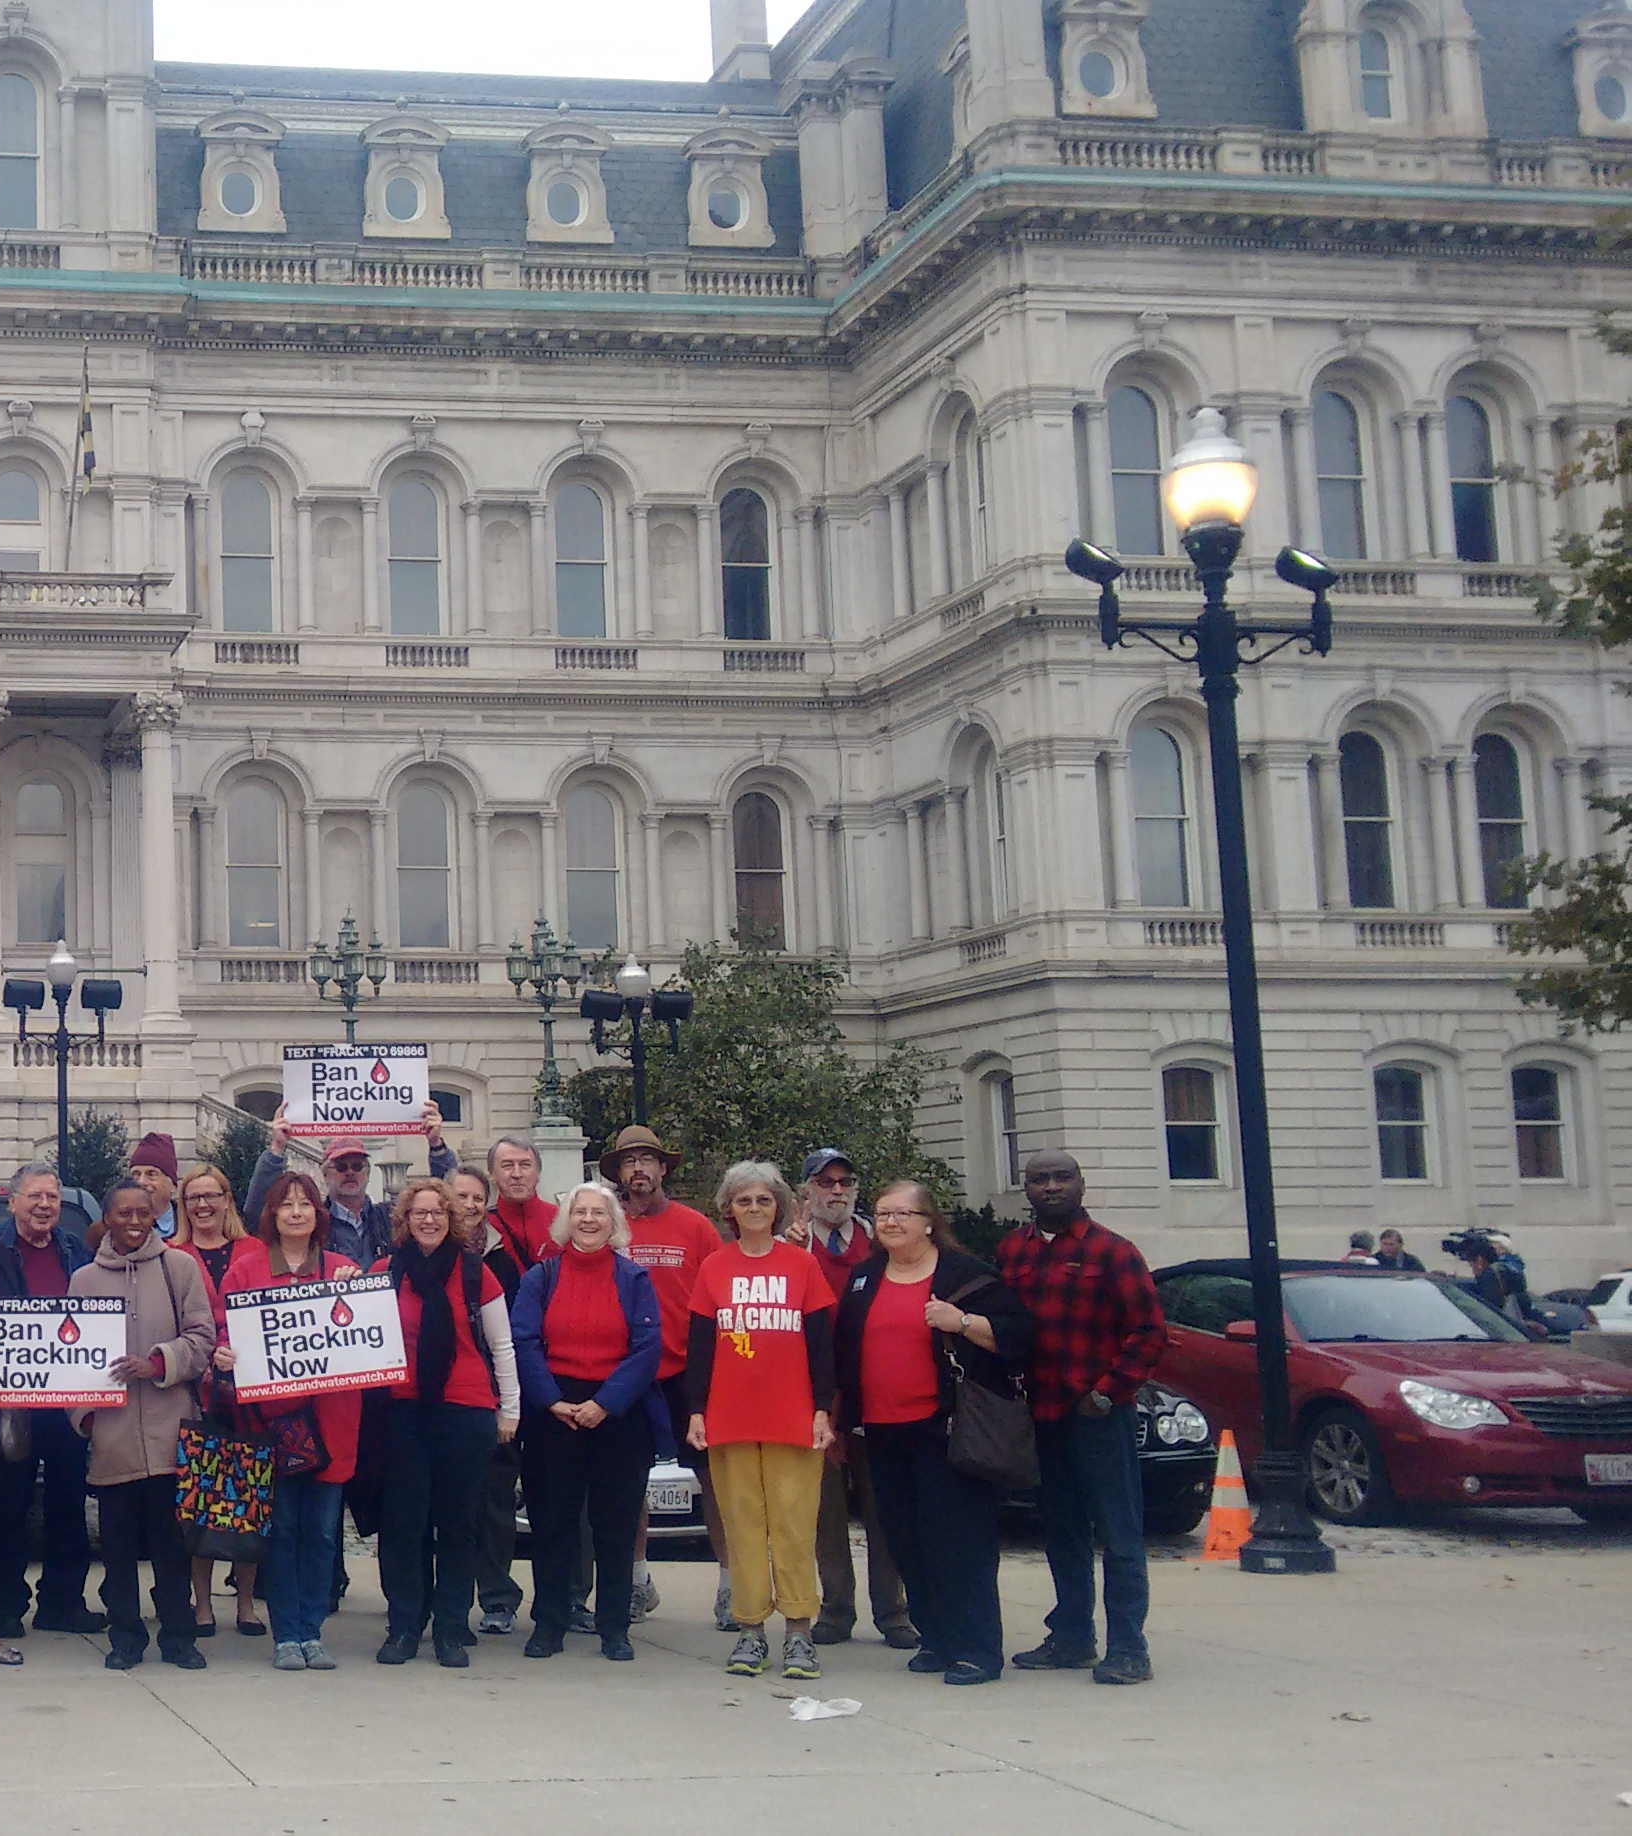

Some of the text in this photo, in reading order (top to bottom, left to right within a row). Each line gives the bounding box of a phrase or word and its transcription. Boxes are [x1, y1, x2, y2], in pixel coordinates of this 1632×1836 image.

[286, 1047, 316, 1058] TEXT
[371, 1046, 387, 1056] TO
[390, 1045, 424, 1056] 69866
[311, 1062, 358, 1081] Ban
[312, 1082, 413, 1105] Fracking
[312, 1102, 365, 1121] Now
[227, 1275, 391, 1307] TEXT "FRACK" TO 69866
[732, 1275, 787, 1304] BAN
[59, 1299, 79, 1312] TO
[81, 1299, 123, 1312] 69866
[260, 1308, 316, 1332] Ban
[717, 1305, 802, 1333] FRACKING
[263, 1324, 384, 1357] Fracking
[267, 1356, 329, 1381] Now
[240, 1370, 405, 1398] www.foodandwaterwatch.org
